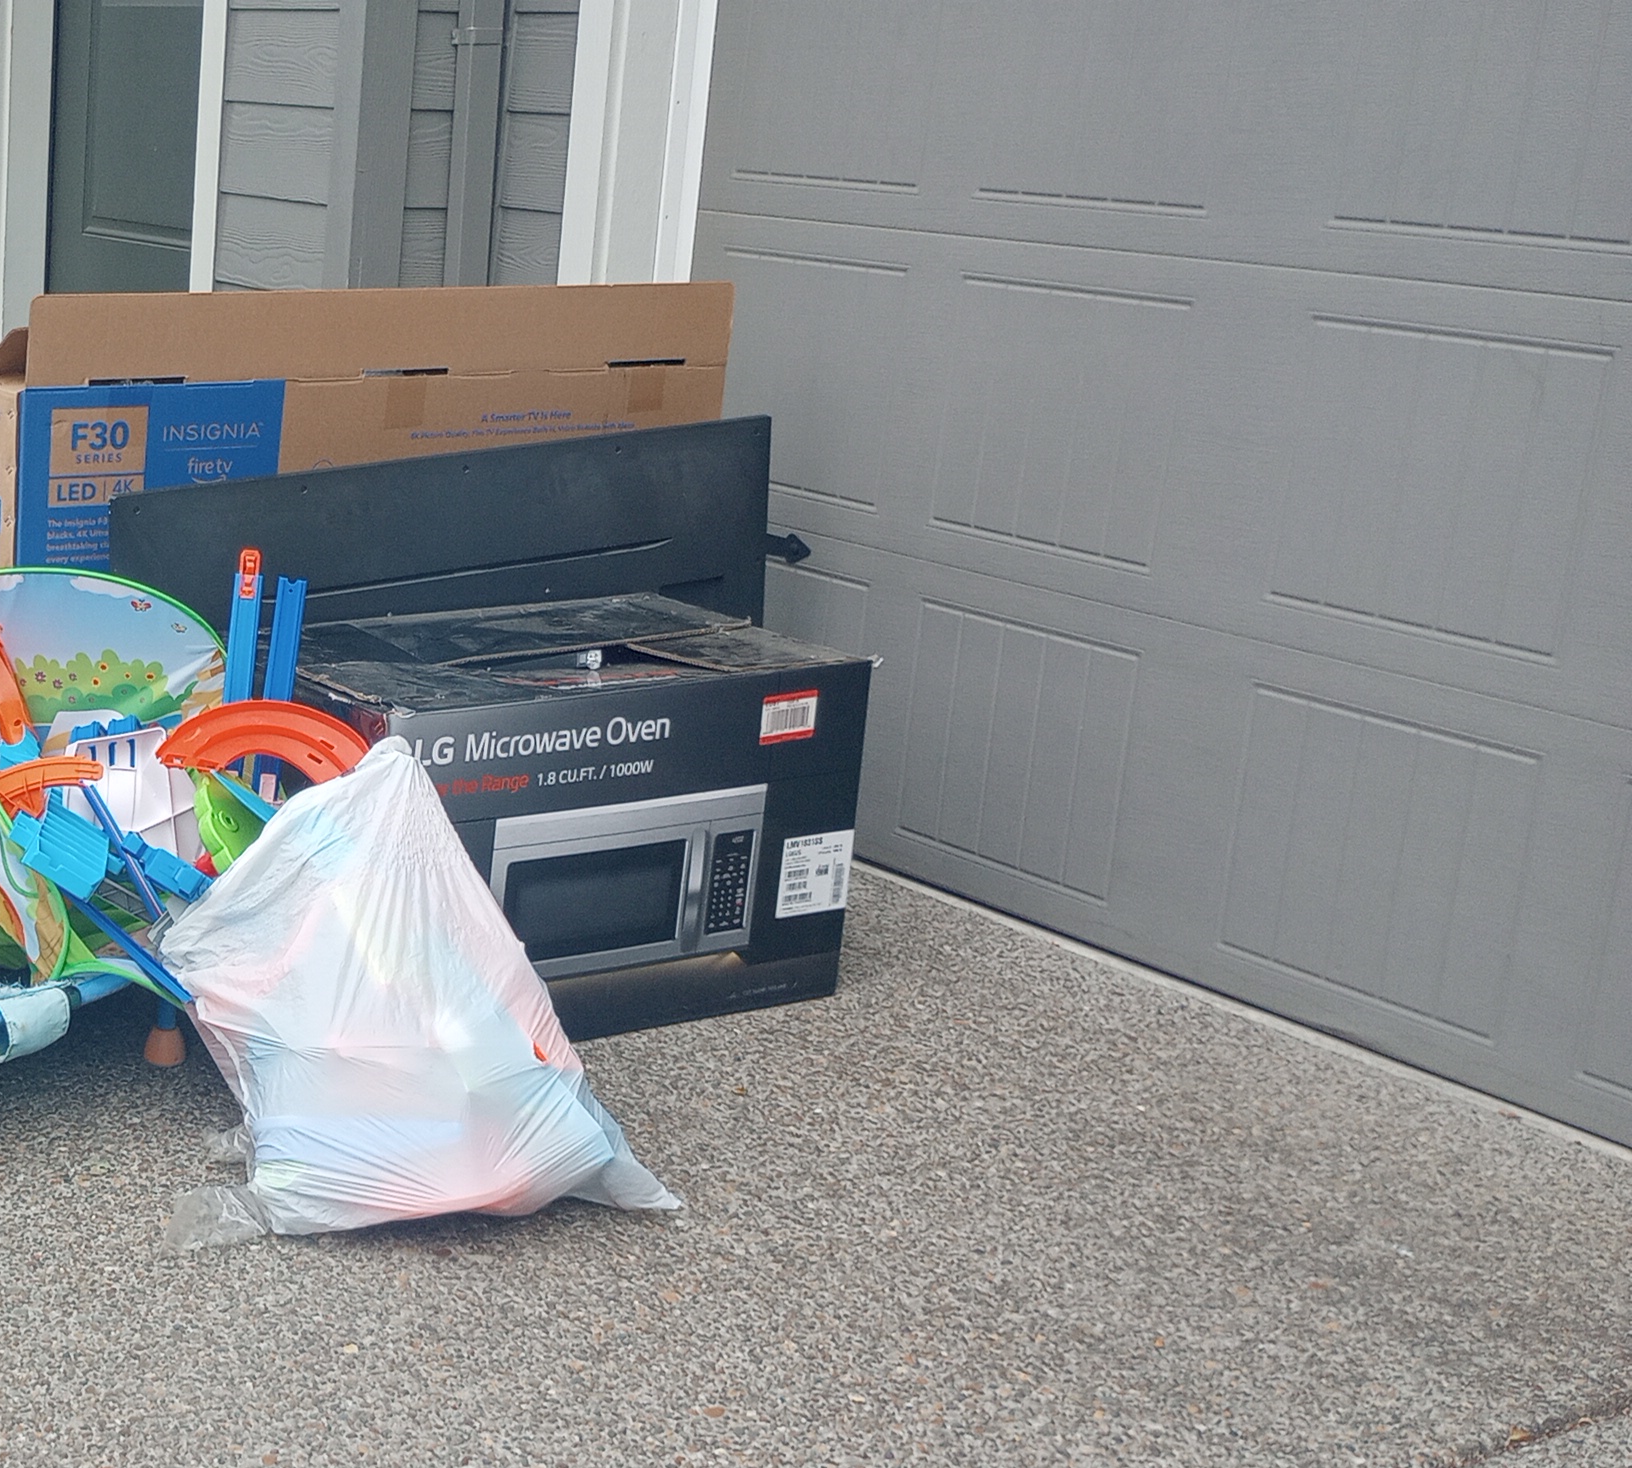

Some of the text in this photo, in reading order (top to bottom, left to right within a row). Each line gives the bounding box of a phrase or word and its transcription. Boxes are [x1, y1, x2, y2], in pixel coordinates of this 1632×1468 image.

[71, 420, 130, 451] F30
[163, 421, 261, 442] INSIGNIA
[75, 452, 122, 464] SERIES
[56, 479, 134, 502] LED 4K
[48, 517, 63, 527] The
[69, 552, 110, 564] experienc
[414, 716, 671, 767] LG Microwave Oven
[452, 776, 479, 796] the
[481, 773, 530, 794] Range
[536, 771, 557, 787] 1.8
[558, 766, 597, 786] CU.FT.
[609, 759, 655, 778] 1000W
